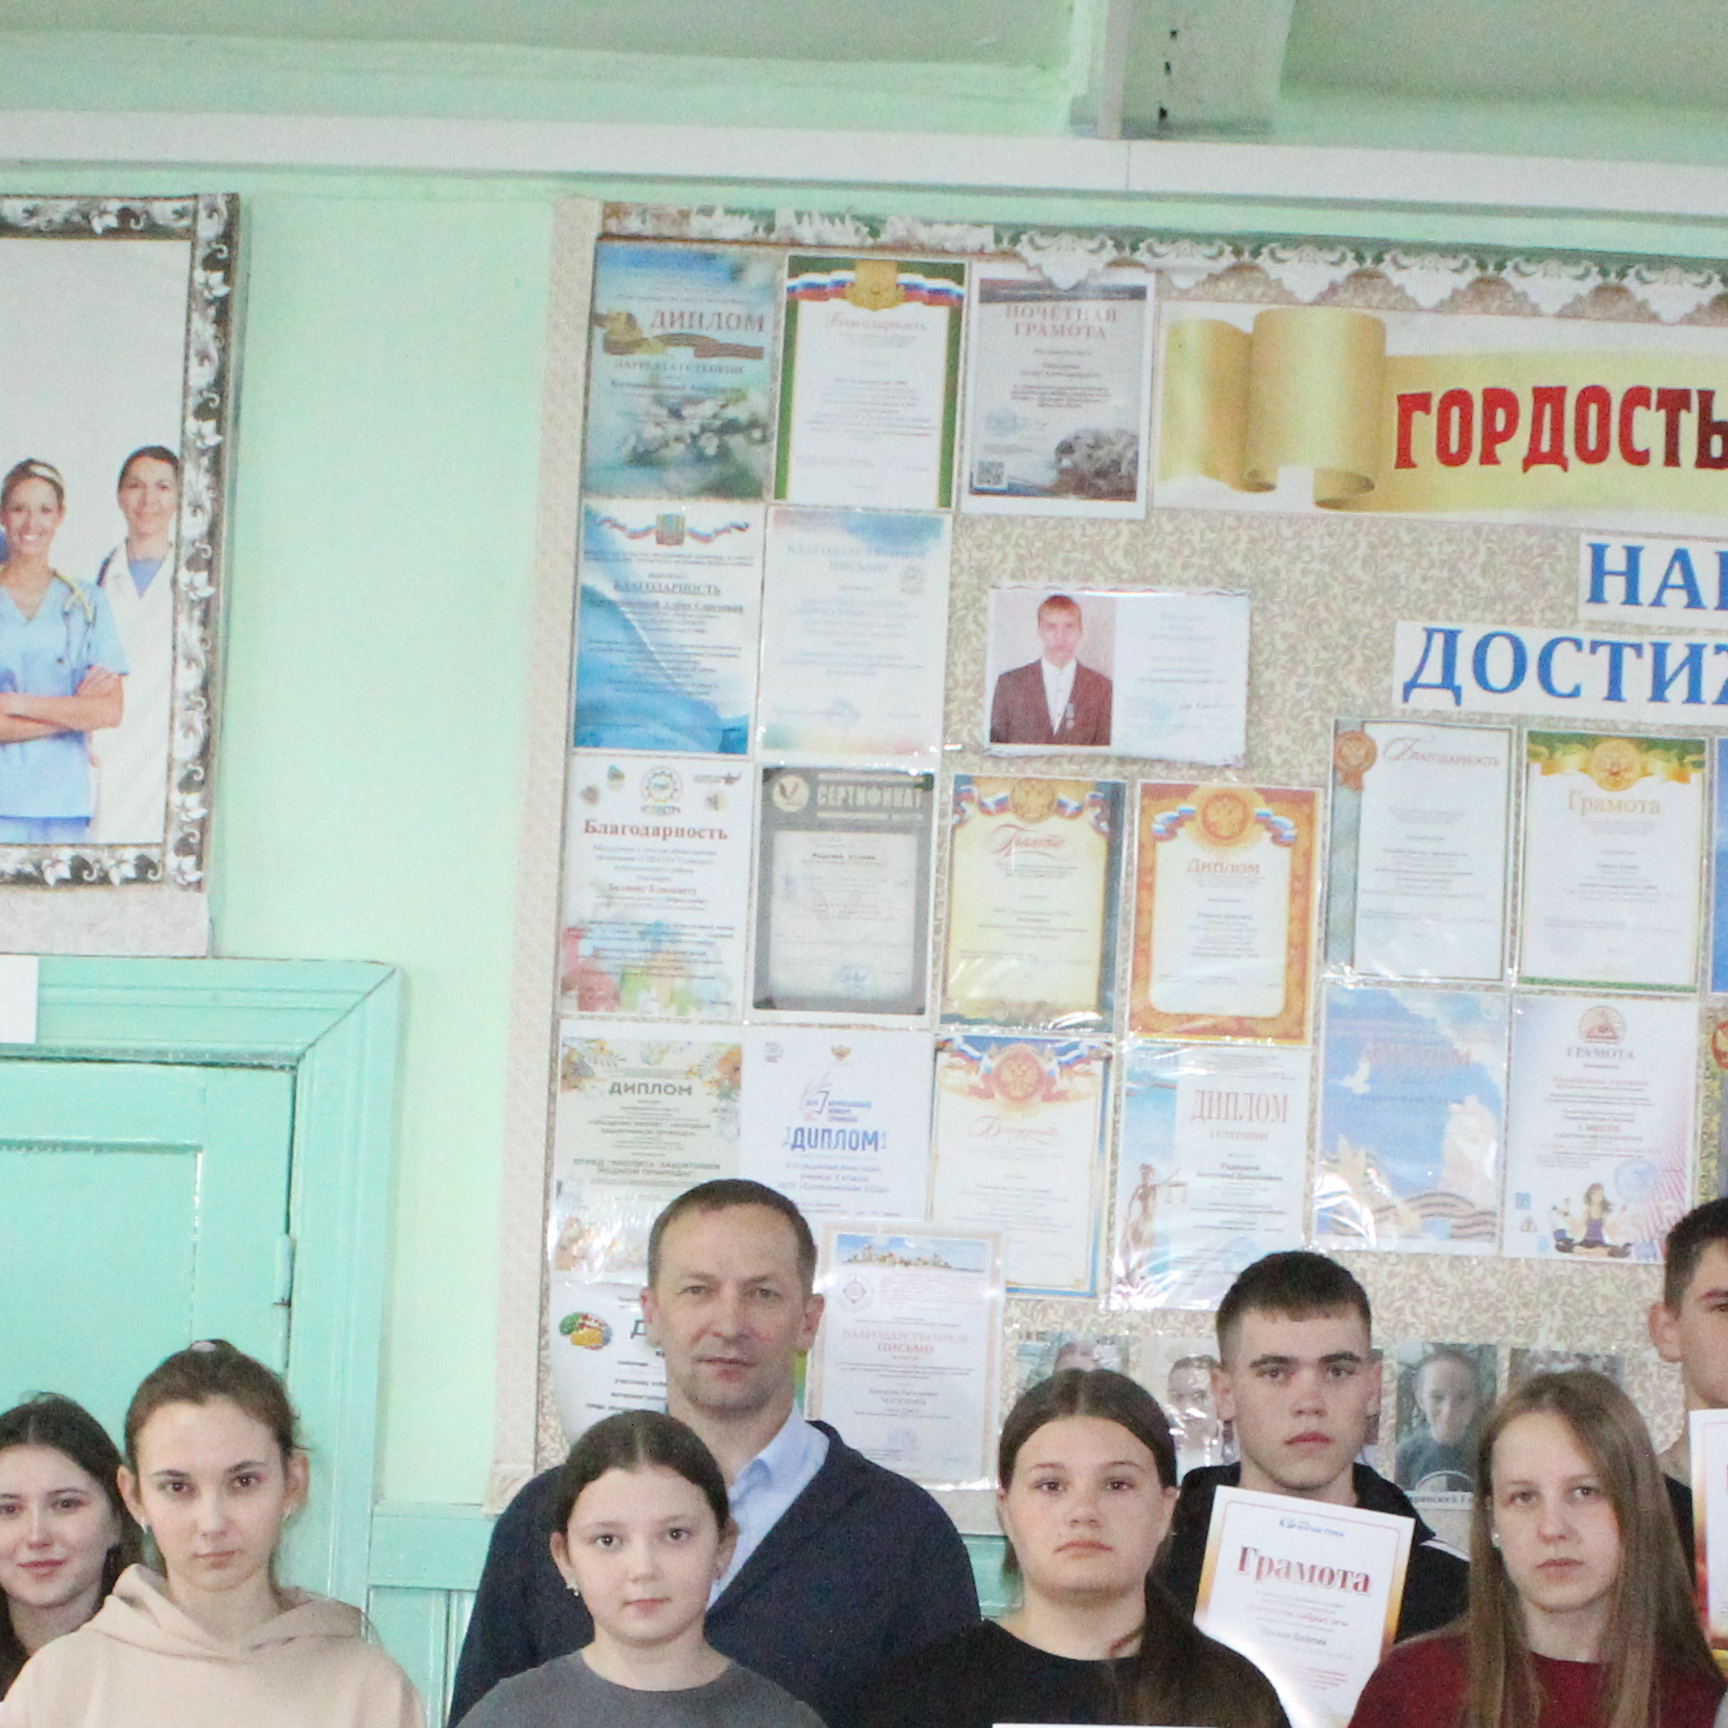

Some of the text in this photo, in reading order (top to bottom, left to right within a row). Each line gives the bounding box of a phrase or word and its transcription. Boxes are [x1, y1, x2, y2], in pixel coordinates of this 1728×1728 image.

[650, 308, 766, 334] ДИПЛОМ
[1015, 322, 1108, 339] ГРАМОТА
[816, 783, 924, 809] СЕРТИФИКАТ
[1568, 790, 1662, 816] Грамота
[584, 819, 729, 842] Благодарность
[608, 1081, 693, 1097] ДИПЛОМ
[1191, 1089, 1290, 1124] ДИПЛОМ
[790, 1127, 880, 1152] ДИПЛОМ
[876, 1343, 935, 1355] ПИСЬМО
[1237, 1546, 1371, 1593] Грамота
